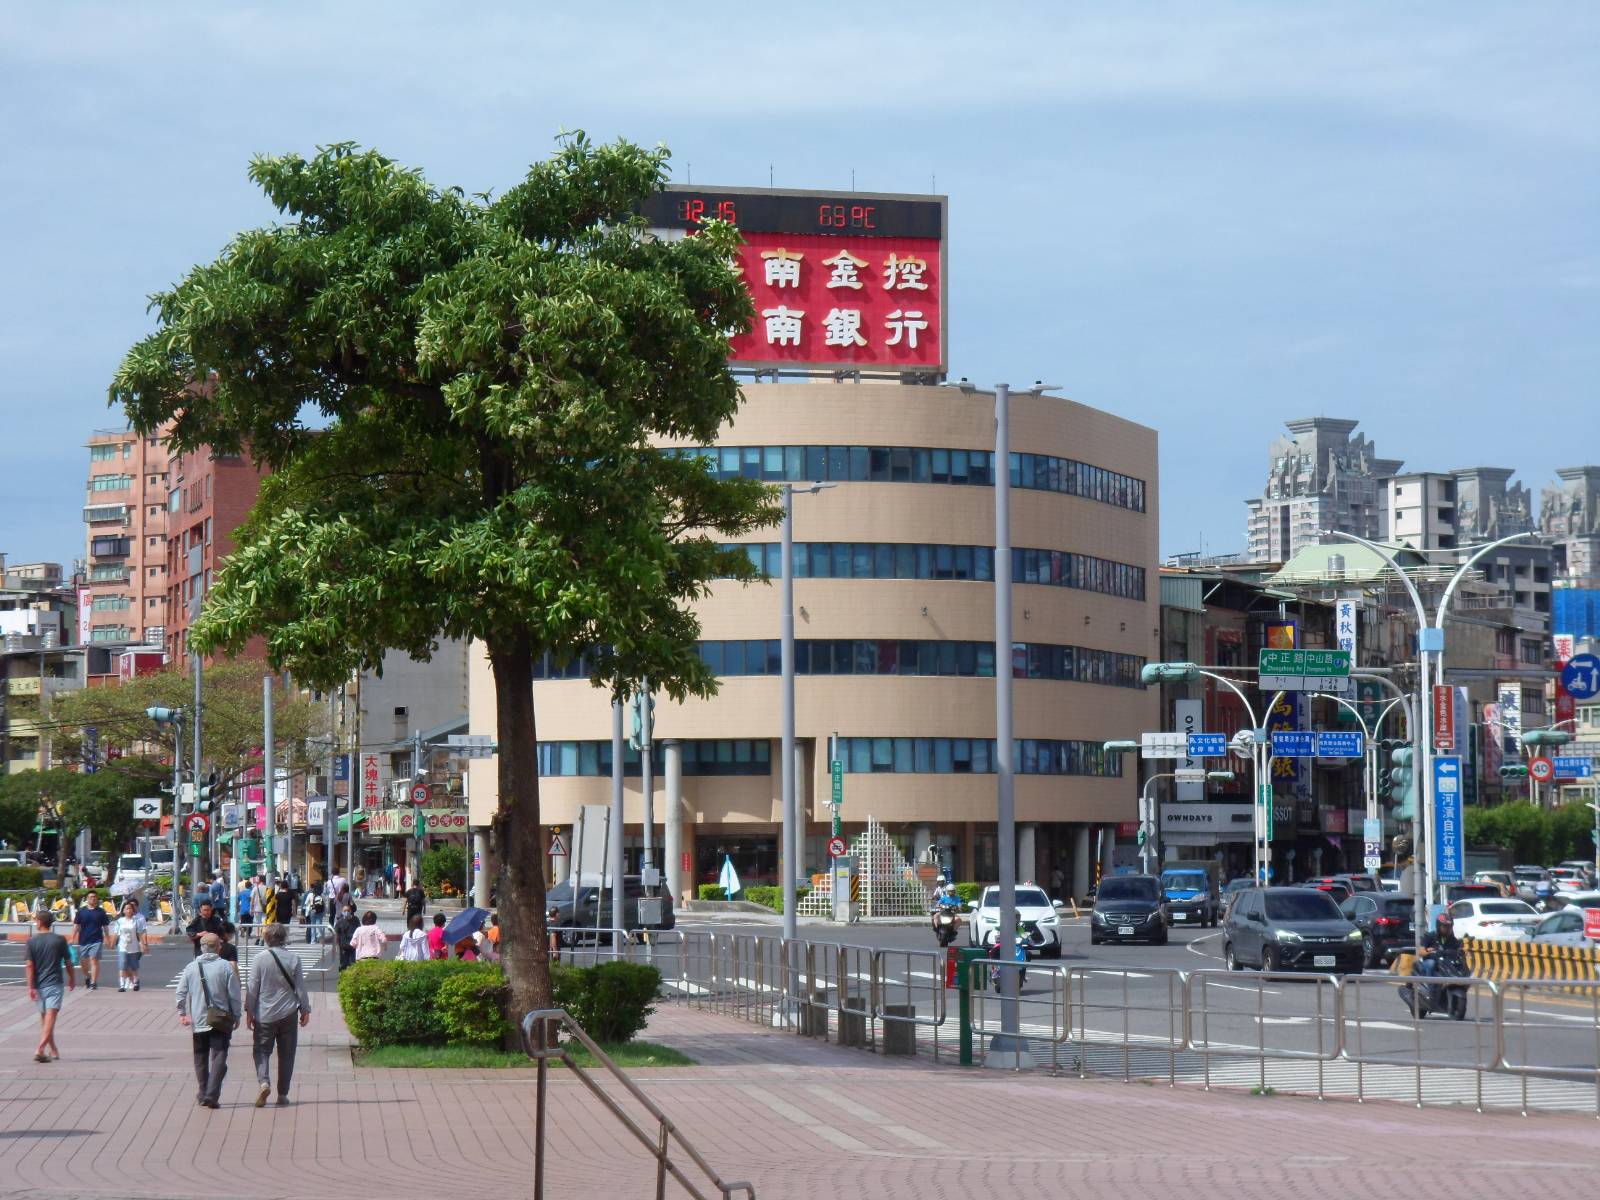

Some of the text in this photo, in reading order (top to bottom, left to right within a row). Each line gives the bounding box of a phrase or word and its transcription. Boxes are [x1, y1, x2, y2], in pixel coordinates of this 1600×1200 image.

[726, 248, 929, 291] 南金控
[726, 305, 929, 348] 南銀行
[1267, 652, 1304, 663] 中正路
[1306, 653, 1333, 664] 中山路
[1533, 763, 1549, 773] 40
[364, 755, 378, 807] 大塊牛排
[415, 791, 425, 799] 30
[1167, 814, 1213, 823] OWNDAYS
[1443, 793, 1455, 871] 河濱自行車道
